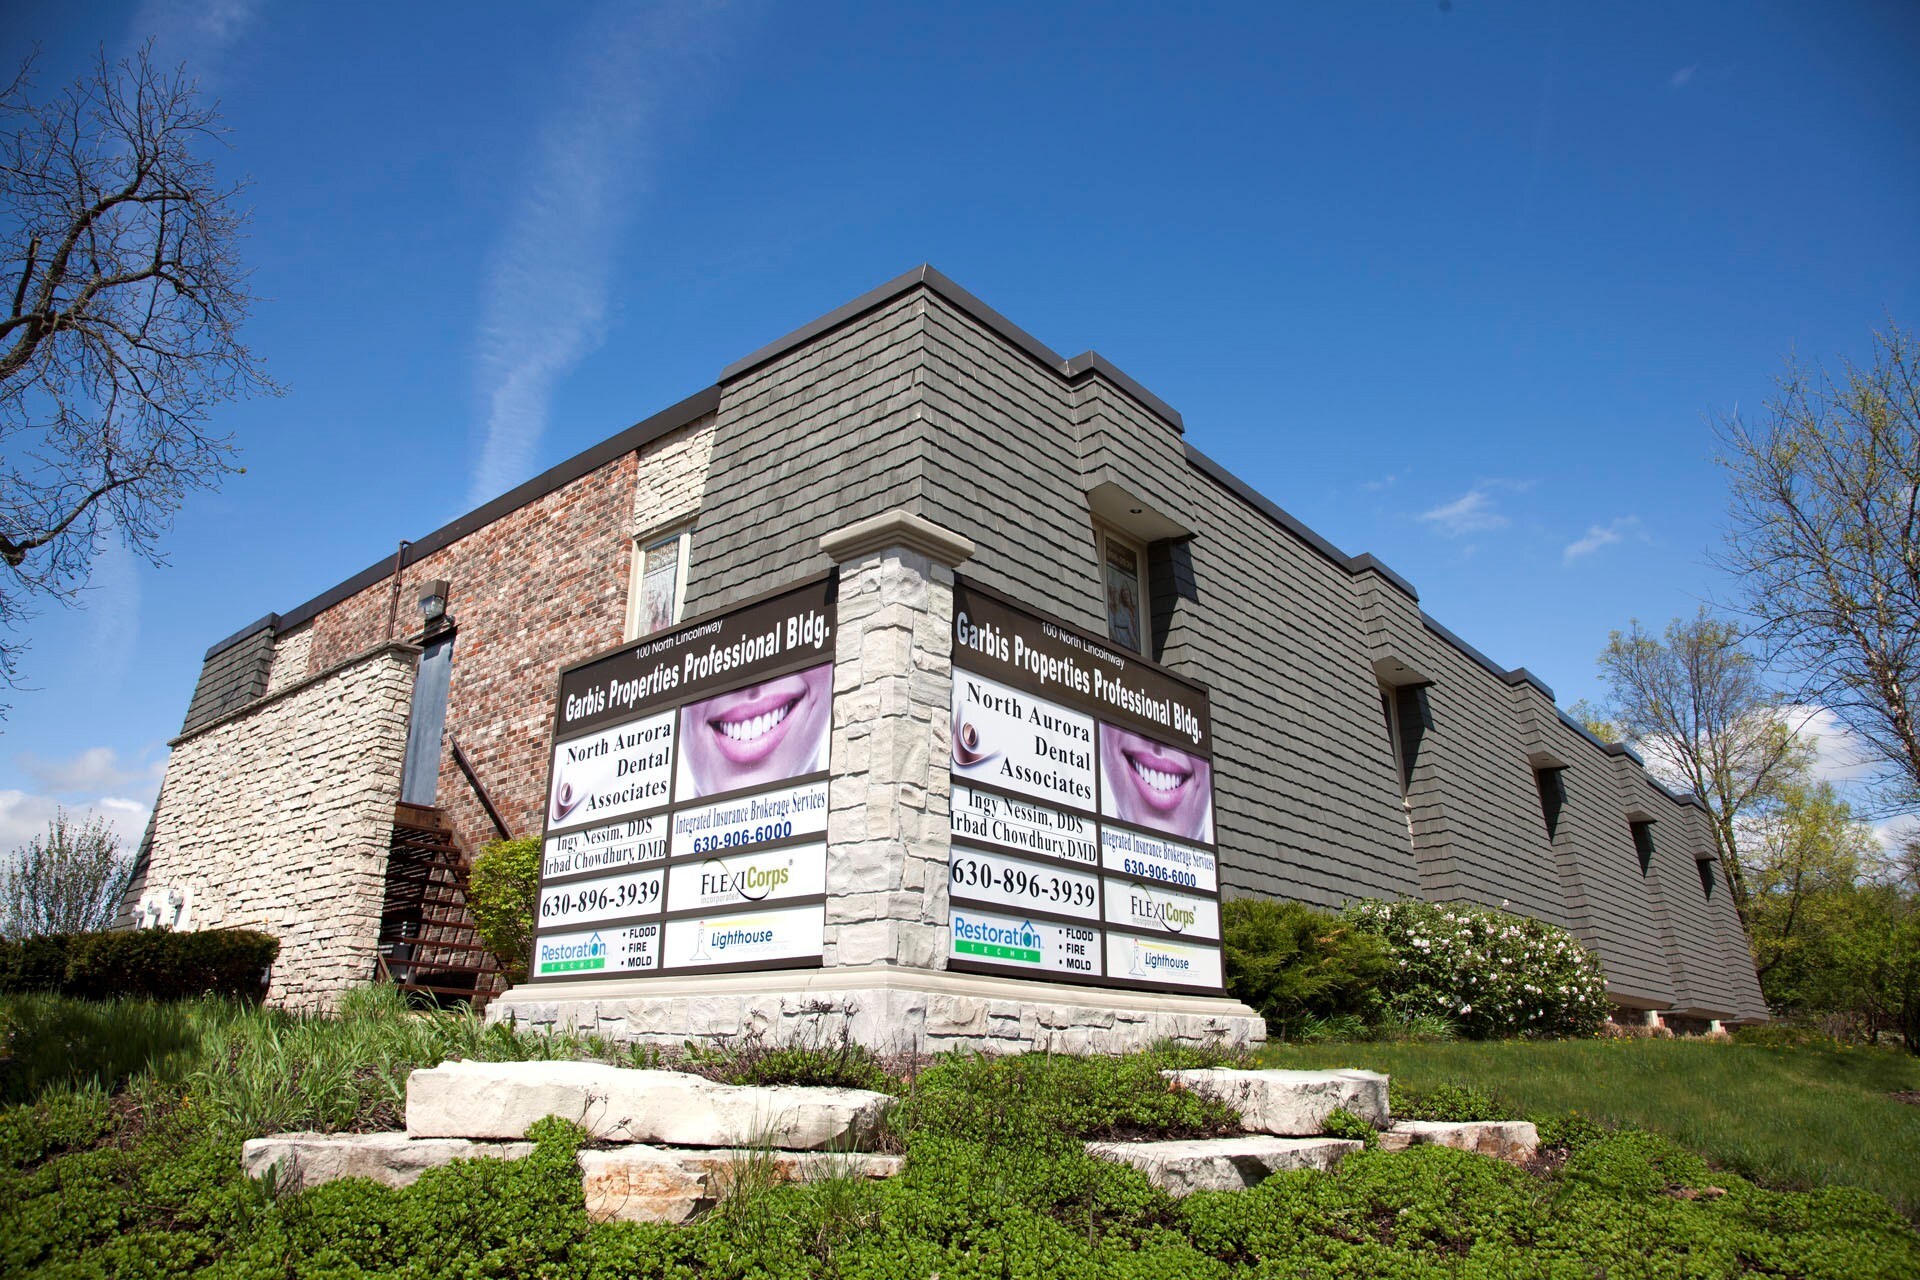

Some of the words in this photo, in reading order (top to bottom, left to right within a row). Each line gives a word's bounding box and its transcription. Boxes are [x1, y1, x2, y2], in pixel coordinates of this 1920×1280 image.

[636, 644, 650, 659] 100
[652, 637, 674, 654] North
[1042, 621, 1057, 638] 100
[1060, 629, 1081, 649] North
[566, 684, 605, 722] Garbis
[609, 662, 679, 709] Properties
[684, 622, 780, 683] Professional
[786, 610, 830, 650] Bldg.
[956, 611, 1009, 662] Garbis
[1015, 634, 1090, 695] Properties
[1094, 668, 1171, 727] Professional
[1174, 701, 1202, 744] Bldg.
[966, 681, 1022, 720] North
[1028, 707, 1090, 743] Aurora
[566, 740, 608, 765] North
[614, 721, 671, 751] Aurora
[1035, 735, 1090, 771] Dental
[617, 748, 670, 777] Dental
[1000, 756, 1091, 799] Associates
[586, 780, 667, 811] Associates
[968, 788, 998, 818] Ingy
[1004, 798, 1053, 830] Nessim,
[1057, 812, 1083, 834] DDS
[676, 809, 711, 837] Integrated
[713, 804, 748, 827] Insurance
[751, 798, 789, 821] Brokerage
[792, 789, 825, 813] Services
[557, 835, 579, 853] Ingy
[628, 817, 652, 837] DDS
[694, 821, 792, 853] 630-906-6000
[950, 810, 988, 837] Irbad
[1068, 839, 1096, 862] DMD
[544, 856, 571, 875] Irbad
[638, 839, 667, 861] DMD
[1102, 831, 1131, 853] ntegrated
[1133, 834, 1162, 859] Insurance
[1163, 842, 1191, 870] Brokerage
[1192, 849, 1214, 872] Services
[952, 857, 1095, 908] 630-896-3939
[1124, 858, 1196, 887] 630-906-6000
[542, 879, 659, 918] 630-896-3939
[628, 942, 647, 953] FIRE
[629, 926, 657, 939] FLOOD
[711, 930, 773, 949] Lighthouse
[955, 917, 1040, 948] Restoration
[1066, 928, 1093, 942] FLOOD
[542, 941, 606, 961] Restoration
[628, 956, 652, 967] MOLD
[971, 944, 1028, 959] TECHS
[1066, 943, 1085, 955] FIRE
[1066, 958, 1091, 971] MOLD
[1145, 952, 1189, 969] Lighthouse
[551, 961, 594, 970] TECHS
